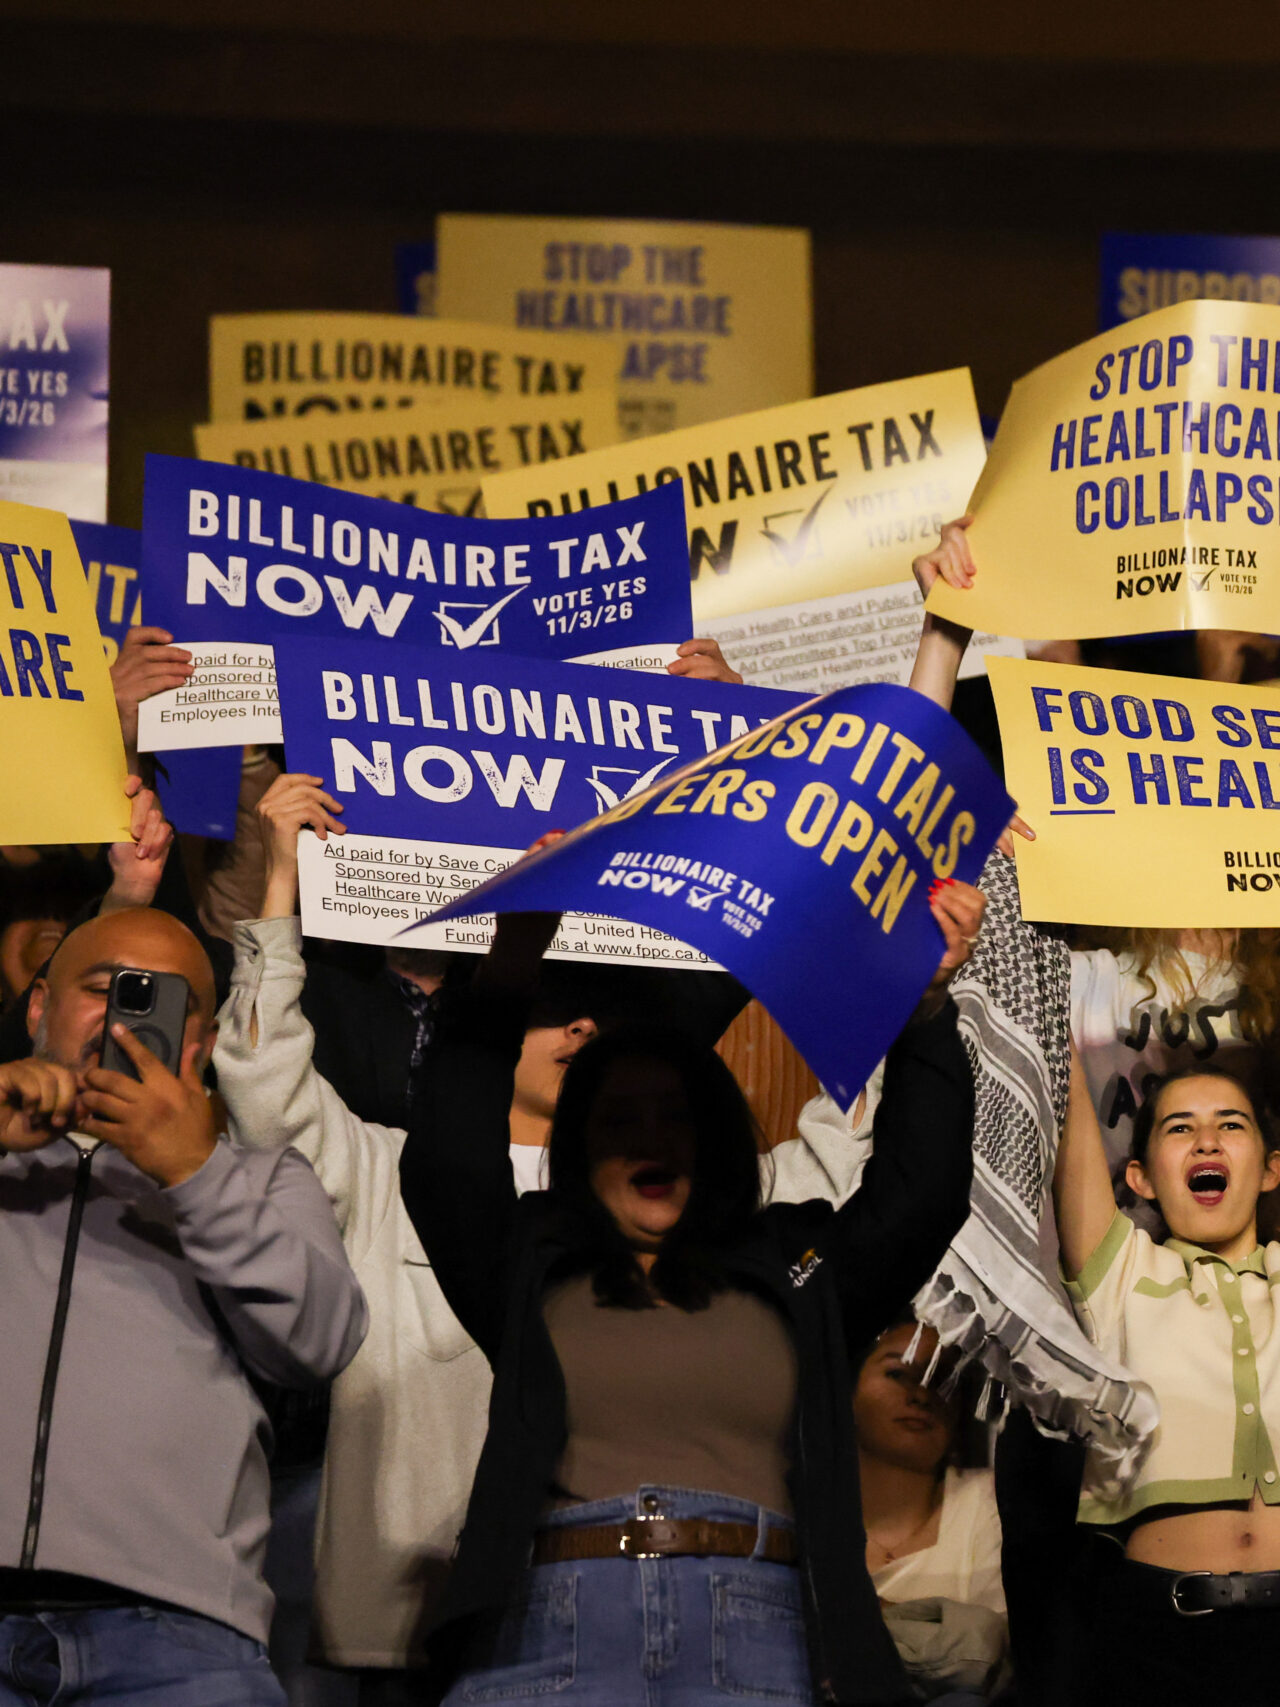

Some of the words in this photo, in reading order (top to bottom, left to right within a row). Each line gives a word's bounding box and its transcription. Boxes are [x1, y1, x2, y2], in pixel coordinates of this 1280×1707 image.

[544, 240, 632, 284] STOP
[643, 244, 704, 287] THE
[8, 300, 70, 353] AX
[514, 288, 731, 337] HEALTHCARE
[28, 369, 68, 397] YES
[242, 340, 501, 393] BILLIONAIRE
[514, 355, 585, 394] TAX
[620, 341, 709, 385] APSE
[1090, 334, 1194, 401] STOP
[510, 418, 586, 465] TAX
[848, 408, 942, 472] TAX
[845, 489, 908, 519] VOTE
[913, 479, 952, 507] YES
[187, 488, 531, 588] BILLIONAIRE
[549, 521, 648, 579] TAX
[1117, 546, 1220, 574] BILLIONAIRE
[1225, 549, 1258, 569] TAX
[1220, 573, 1240, 584] VOTE
[1242, 575, 1257, 585] YES
[186, 551, 414, 638] NOW
[532, 587, 593, 616] VOTE
[601, 576, 648, 601] YES
[1116, 571, 1183, 600] NOW
[1224, 584, 1253, 595] 11/3/26
[546, 601, 633, 636] 11/3/26
[194, 653, 227, 668] paid
[233, 653, 254, 666] for
[258, 655, 275, 669] by
[160, 706, 246, 723] Employees
[175, 687, 260, 704] Healthcare
[322, 670, 680, 754] BILLIONAIRE
[1030, 686, 1195, 743] FOOD
[331, 737, 566, 812] NOW
[1048, 747, 1110, 806] IS
[324, 843, 345, 858] Ad
[351, 848, 383, 864] paid
[389, 850, 410, 864] for
[415, 853, 433, 869] by
[439, 855, 479, 871] Save
[335, 862, 421, 886] Sponsored
[426, 873, 445, 888] by
[786, 781, 919, 934] OPEN
[336, 881, 421, 902] Healthcare
[597, 868, 686, 897] NOW
[609, 851, 738, 893] BILLIONAIRE
[737, 879, 775, 917] TAX
[322, 897, 409, 919] Employees
[722, 900, 747, 919] VOTE
[745, 913, 763, 931] YES
[574, 941, 592, 953] at
[584, 922, 635, 939] United
